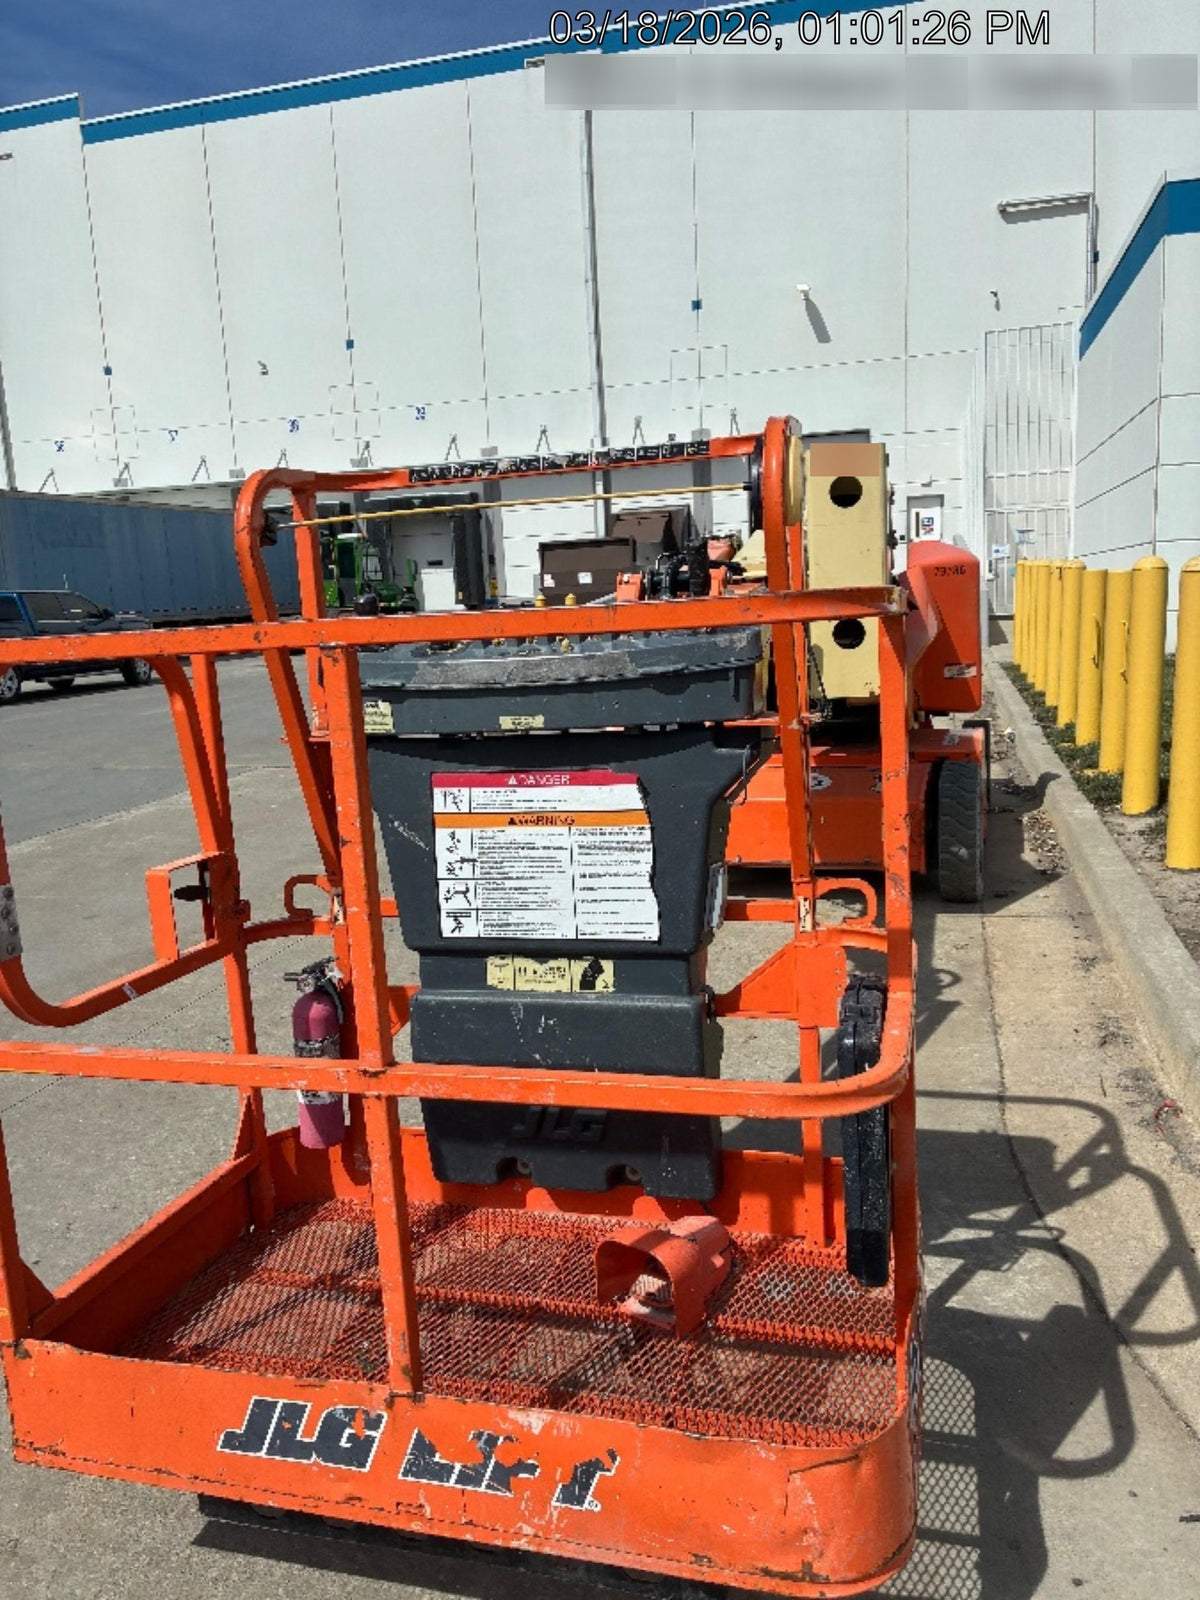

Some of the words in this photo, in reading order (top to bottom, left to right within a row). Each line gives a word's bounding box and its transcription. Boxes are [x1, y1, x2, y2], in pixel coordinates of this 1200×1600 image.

[519, 774, 570, 785] DANGER
[517, 815, 576, 826] WARNING
[510, 1105, 608, 1142] JLG
[216, 1395, 388, 1472] JLG
